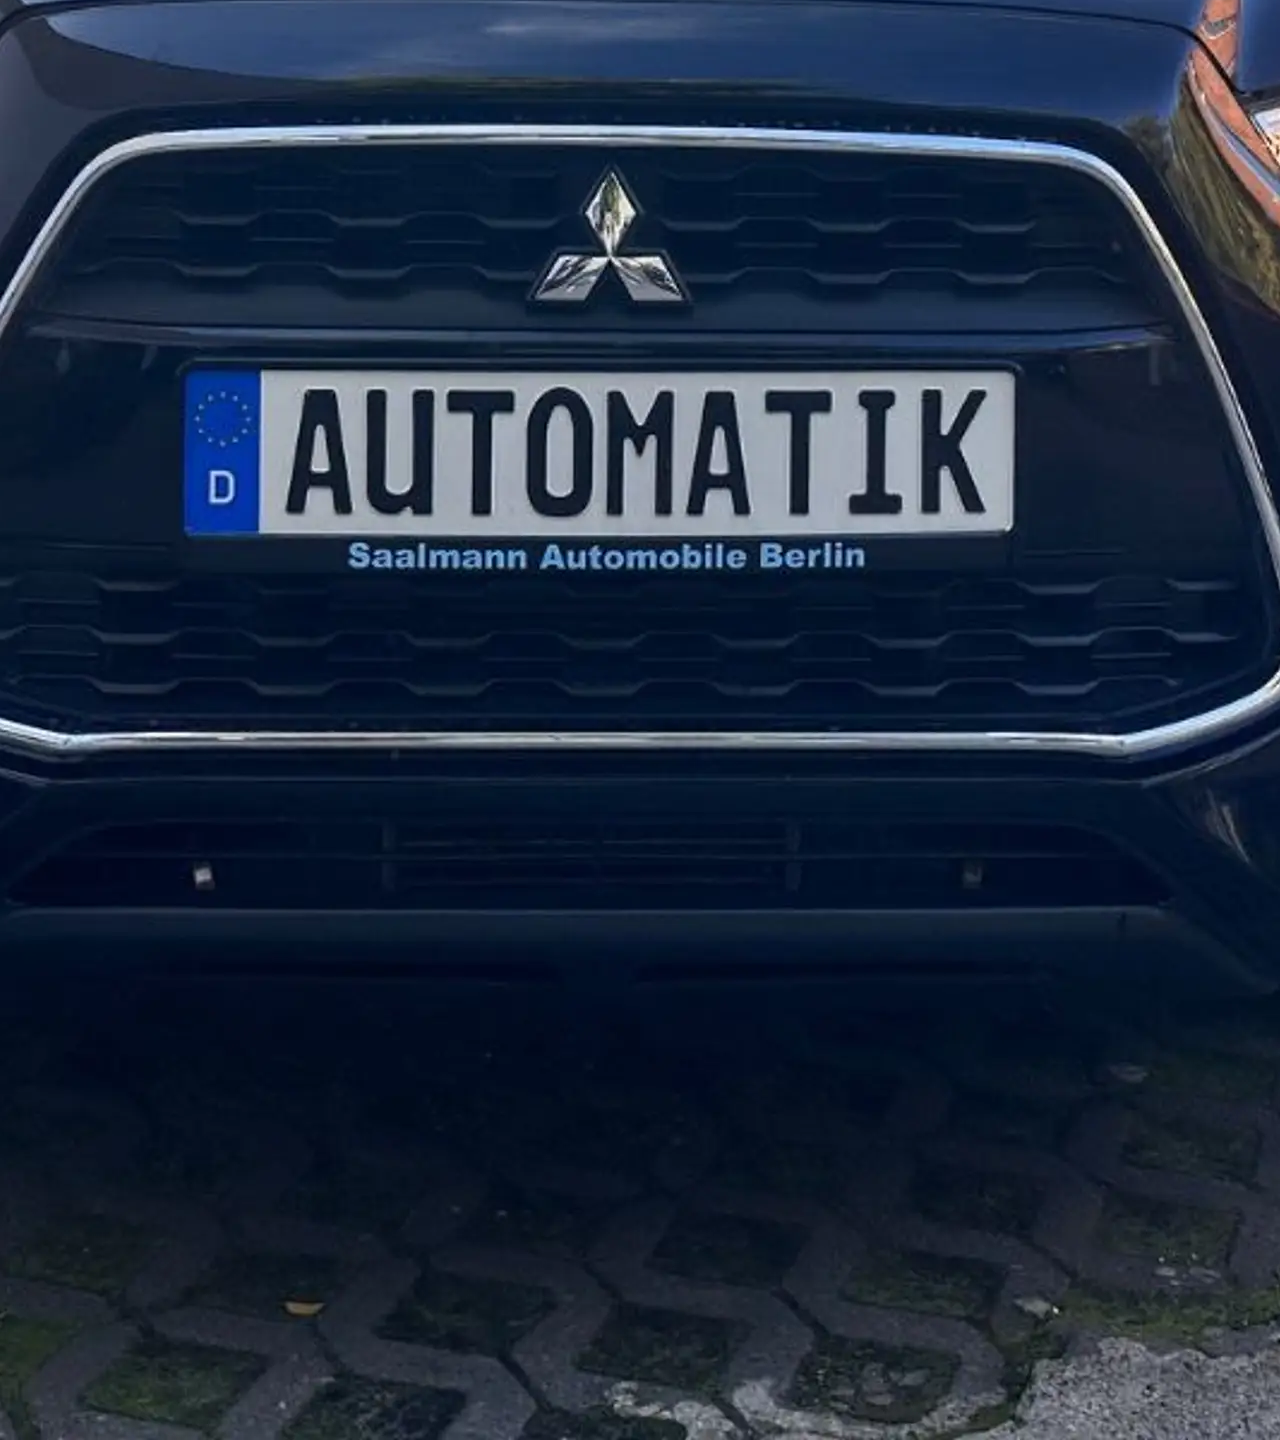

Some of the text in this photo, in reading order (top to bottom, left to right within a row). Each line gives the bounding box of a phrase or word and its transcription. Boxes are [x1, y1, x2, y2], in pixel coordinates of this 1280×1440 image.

[285, 387, 988, 517] AUTOMATIK
[208, 469, 236, 504] D
[347, 541, 866, 570] Saalmann Automobile Berlin
